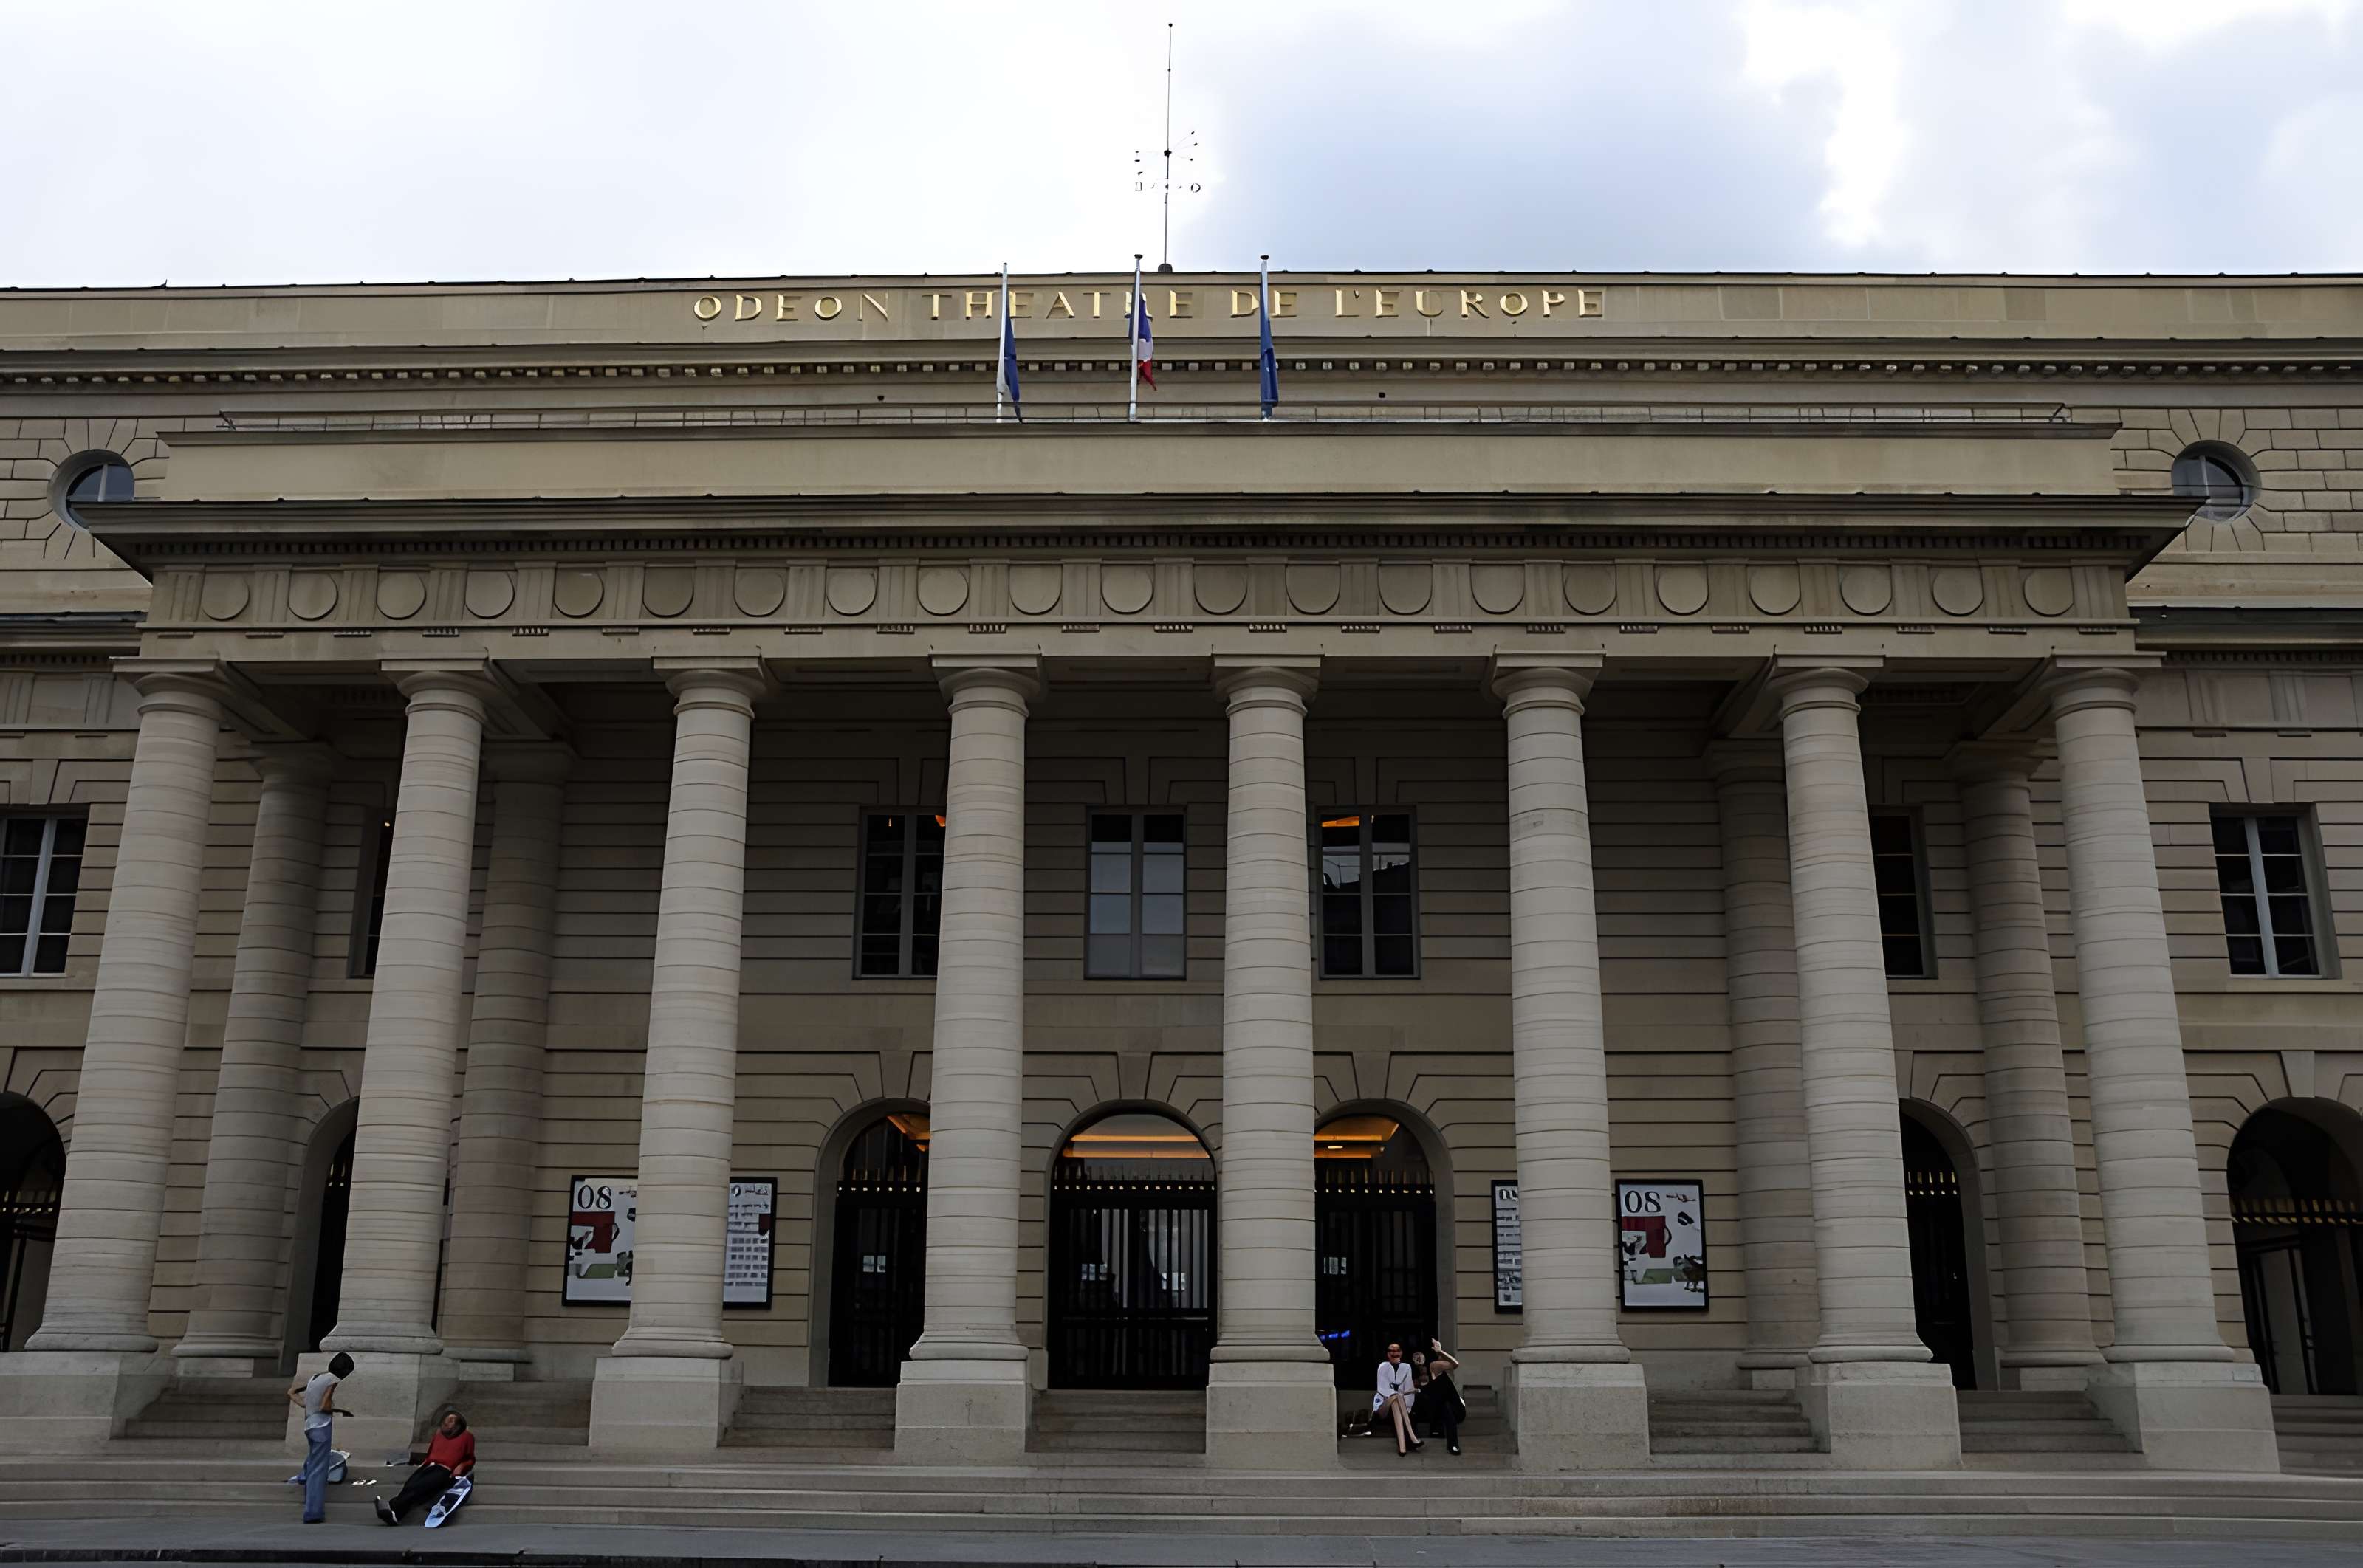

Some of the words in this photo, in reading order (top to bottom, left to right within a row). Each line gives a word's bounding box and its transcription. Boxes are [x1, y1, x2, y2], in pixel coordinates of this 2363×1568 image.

[693, 292, 888, 321] ODEON
[1230, 290, 1297, 318] DE
[1335, 289, 1604, 318] L'EUROPE
[577, 1185, 612, 1209] 08
[1625, 1190, 1661, 1213] 08
